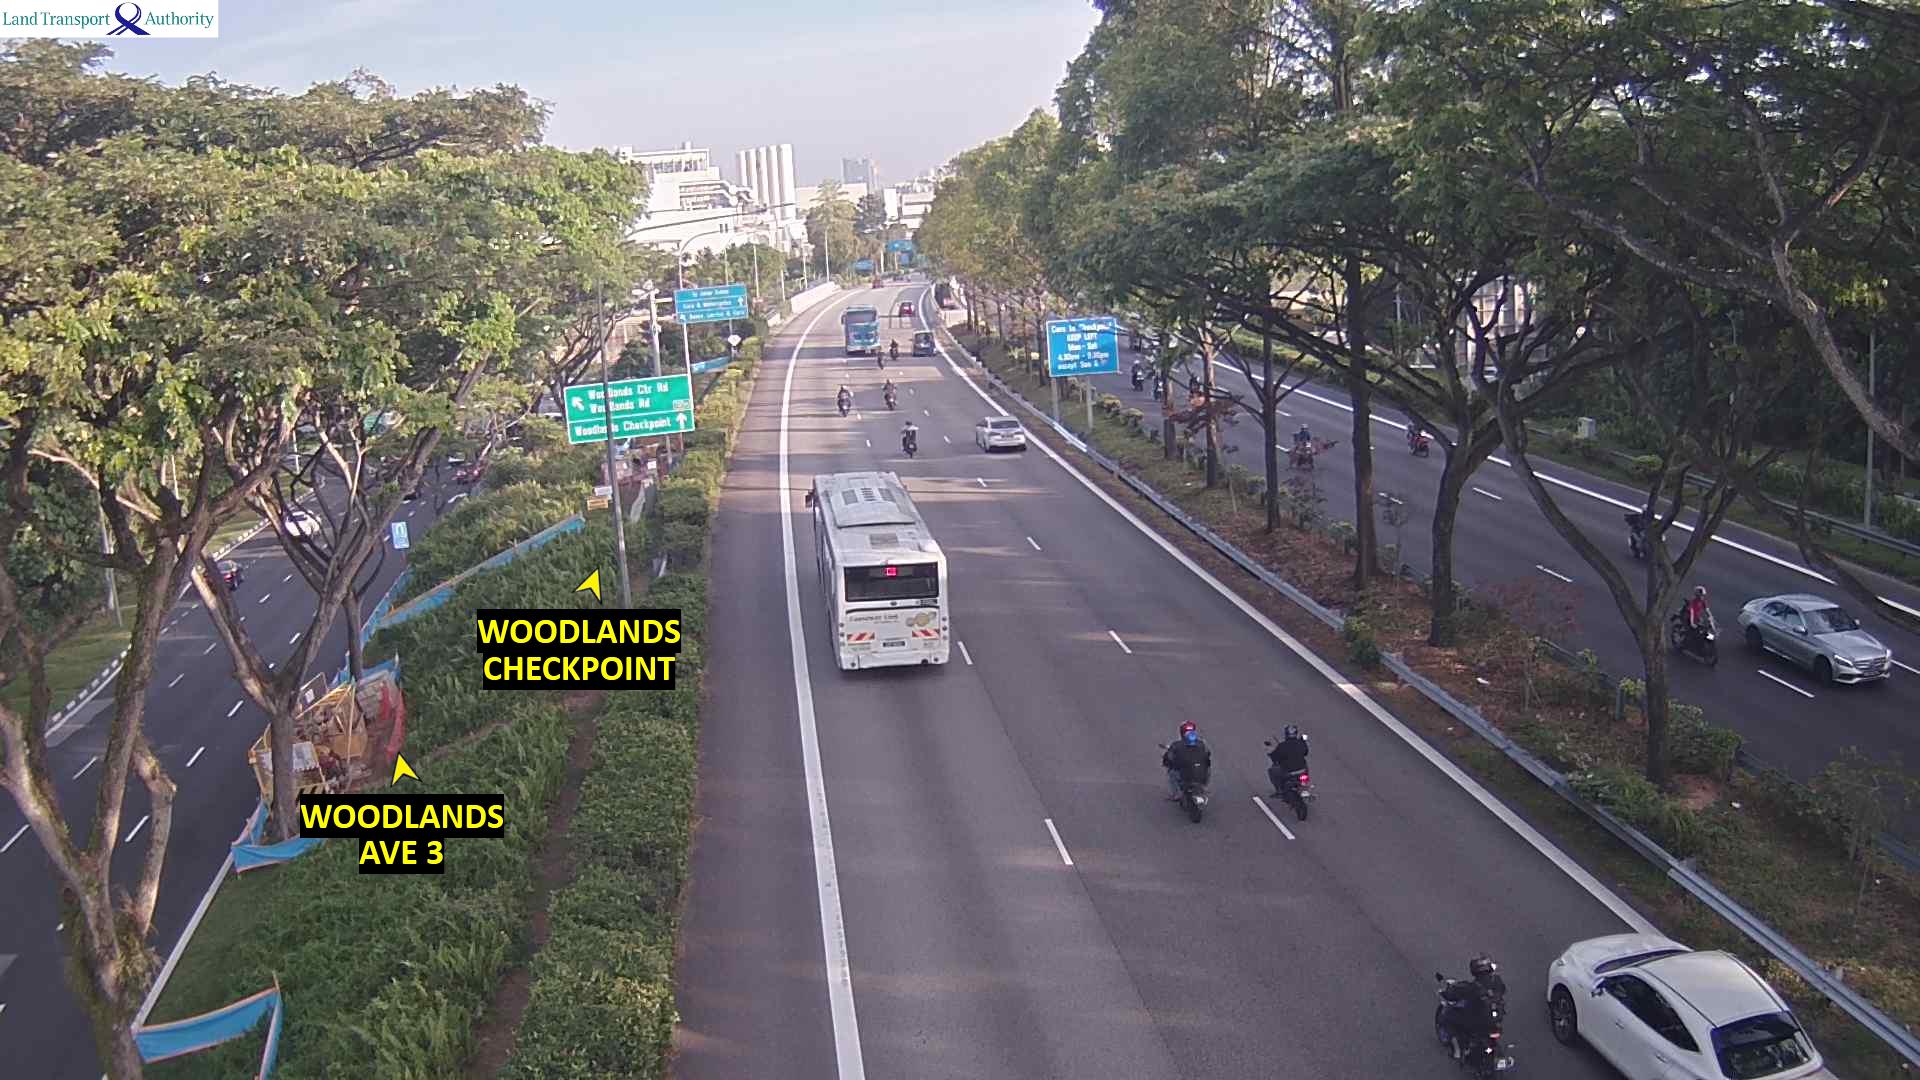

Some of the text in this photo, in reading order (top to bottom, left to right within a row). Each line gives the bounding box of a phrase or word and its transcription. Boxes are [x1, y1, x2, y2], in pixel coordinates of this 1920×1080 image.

[1084, 332, 1097, 340] LEFT
[637, 384, 652, 395] Ctr
[657, 382, 668, 392] Rd
[639, 398, 650, 408] Rd
[624, 417, 671, 431] Checkpoint
